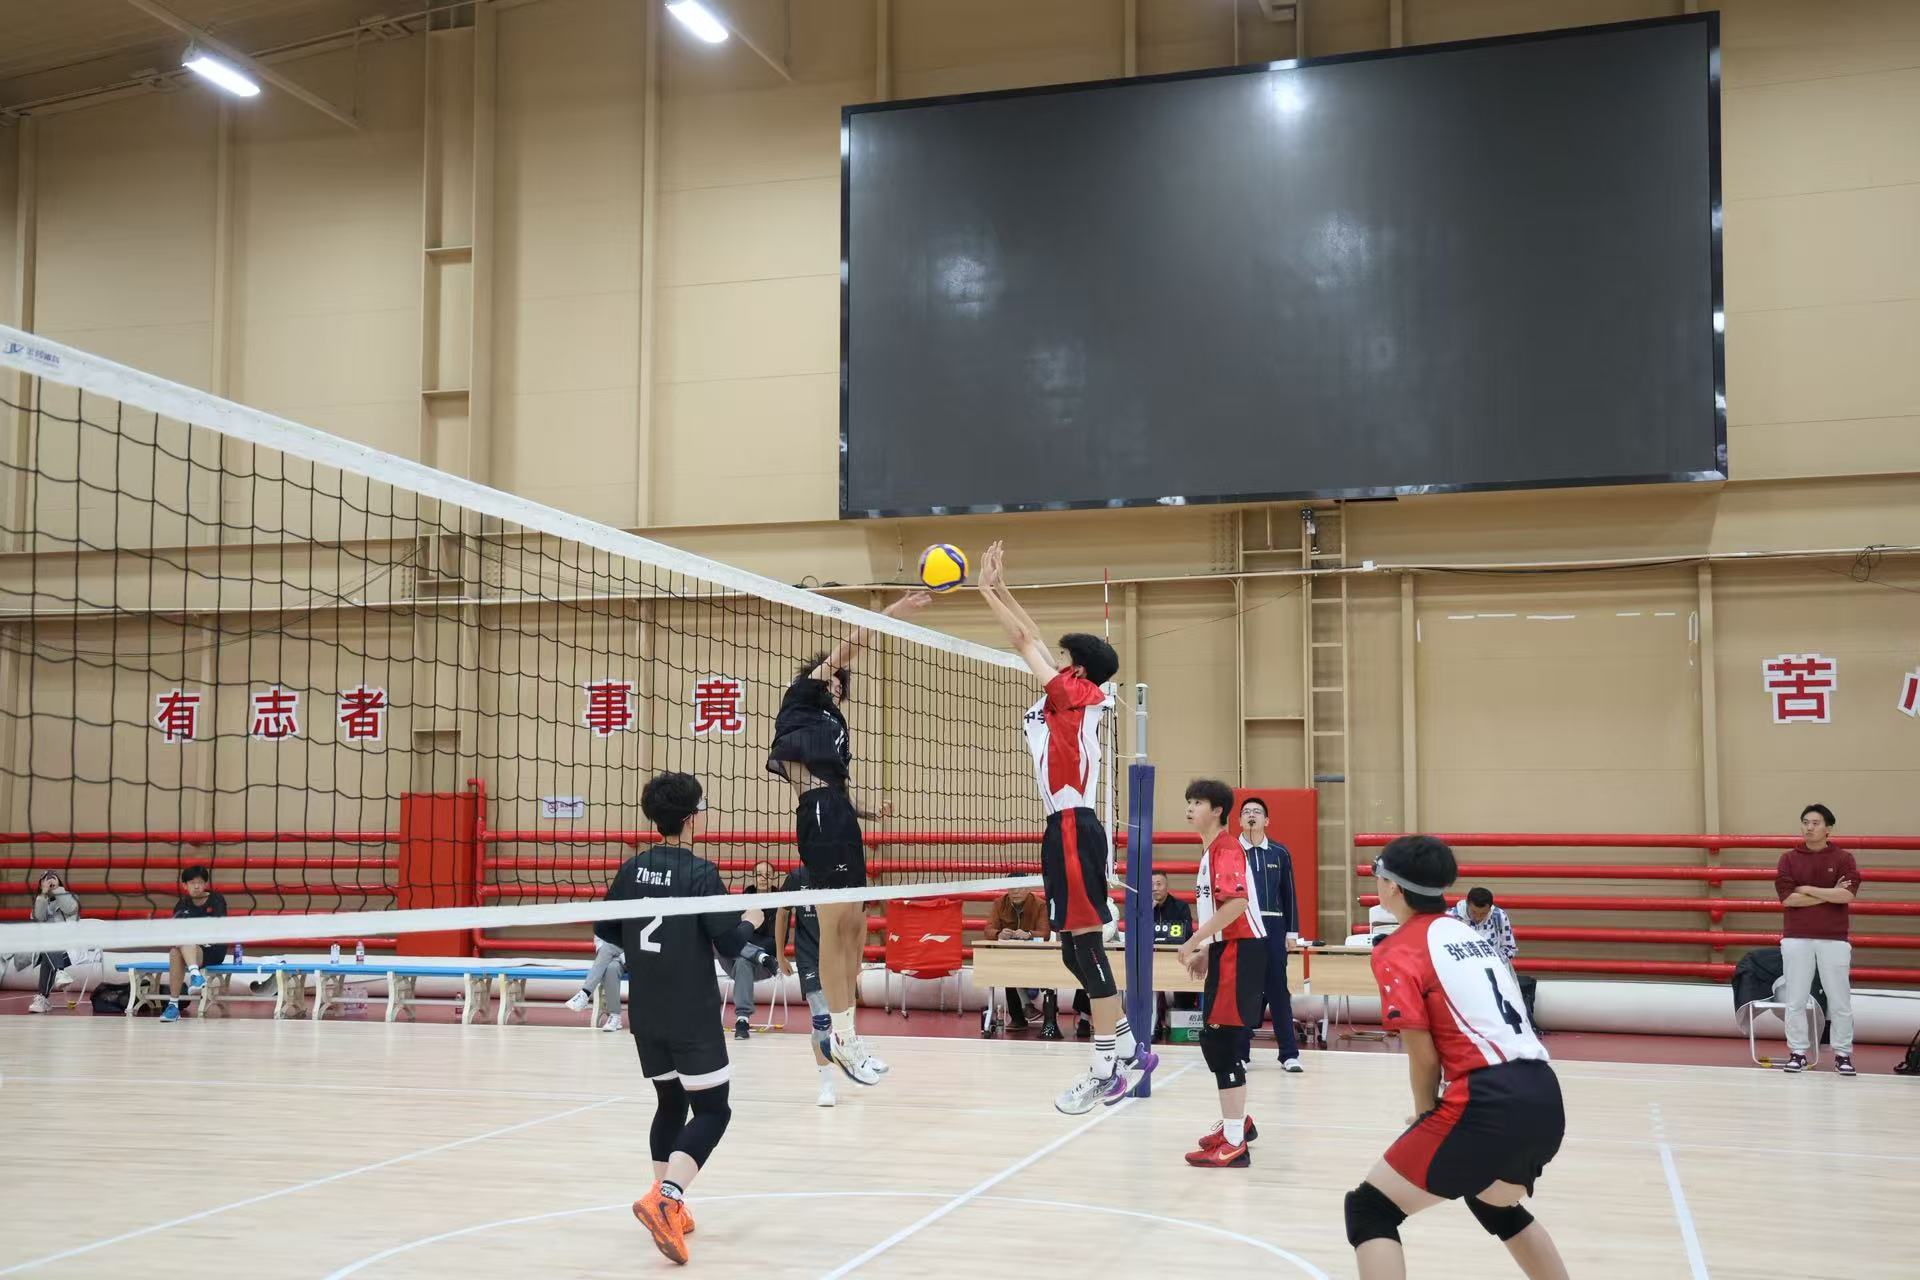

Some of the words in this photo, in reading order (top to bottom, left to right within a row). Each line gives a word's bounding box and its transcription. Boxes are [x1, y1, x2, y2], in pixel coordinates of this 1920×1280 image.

[157, 687, 385, 742] 有志者
[634, 867, 672, 887] Zhou.A
[640, 915, 662, 953] 2
[1169, 924, 1181, 937] 8
[1484, 967, 1523, 1035] 4
